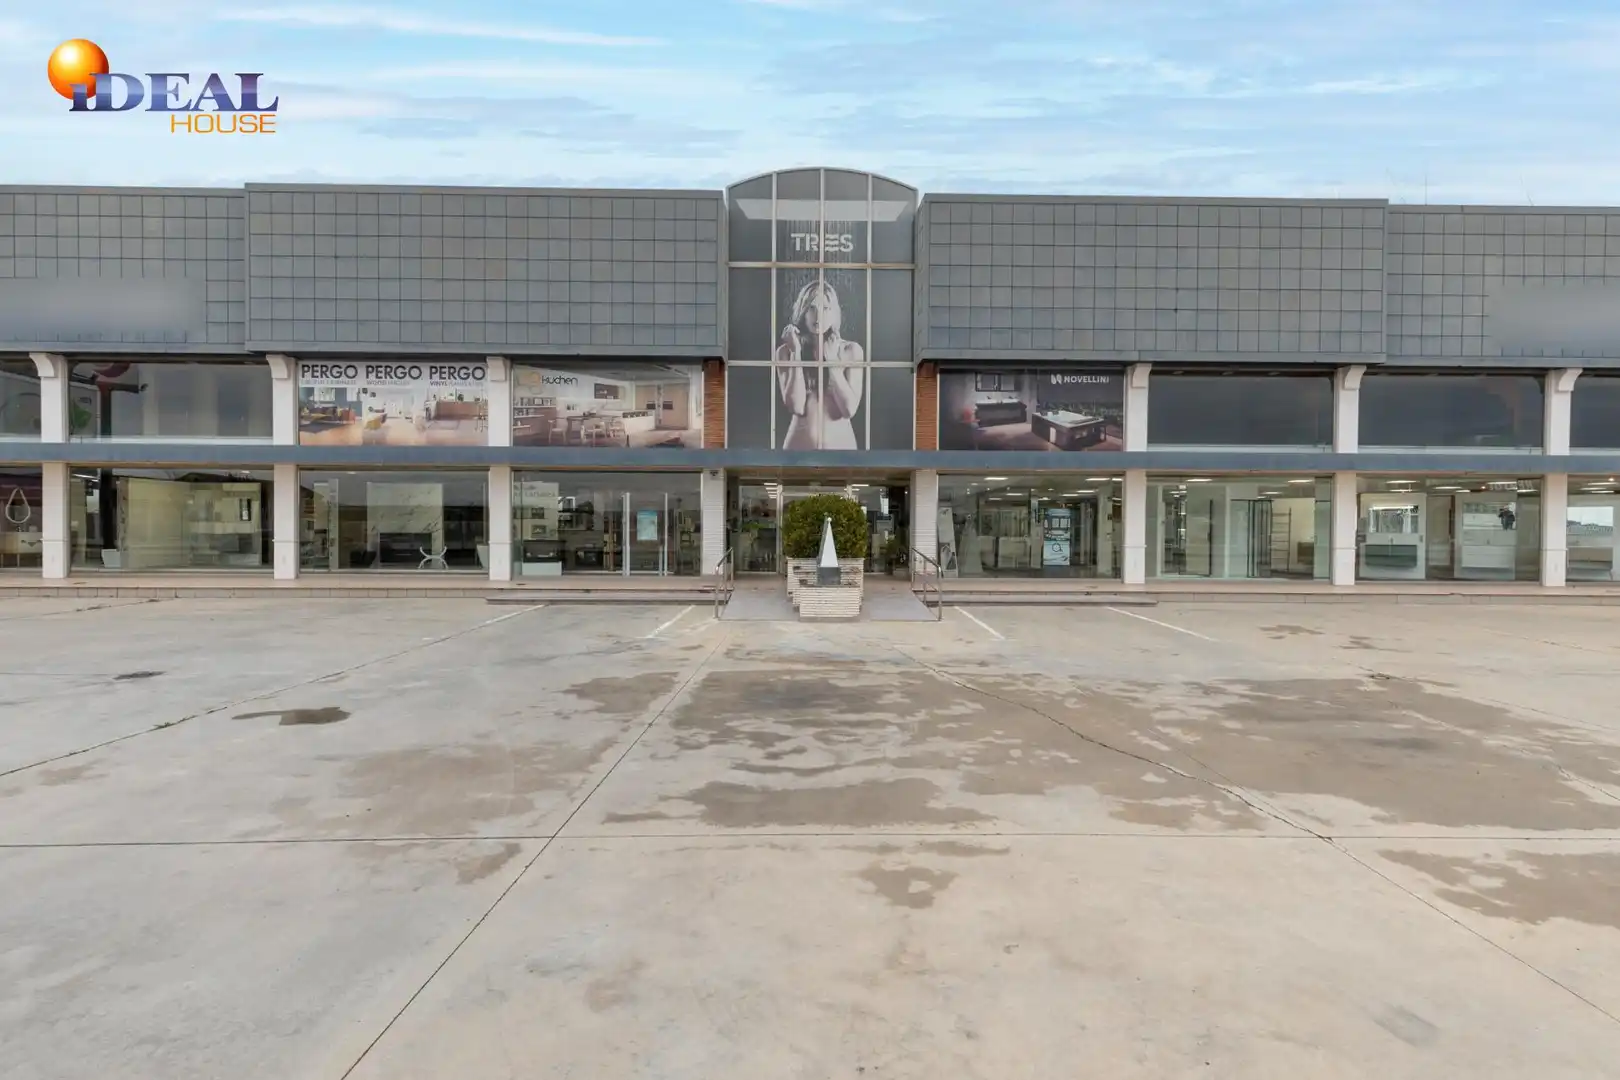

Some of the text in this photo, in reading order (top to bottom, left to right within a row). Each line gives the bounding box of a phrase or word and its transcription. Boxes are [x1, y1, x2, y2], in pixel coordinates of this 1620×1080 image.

[790, 232, 854, 252] TRES
[301, 364, 358, 379] PERGO
[365, 365, 422, 380] PERGO
[429, 365, 486, 380] PERGO
[1063, 375, 1110, 384] NOVELLINI
